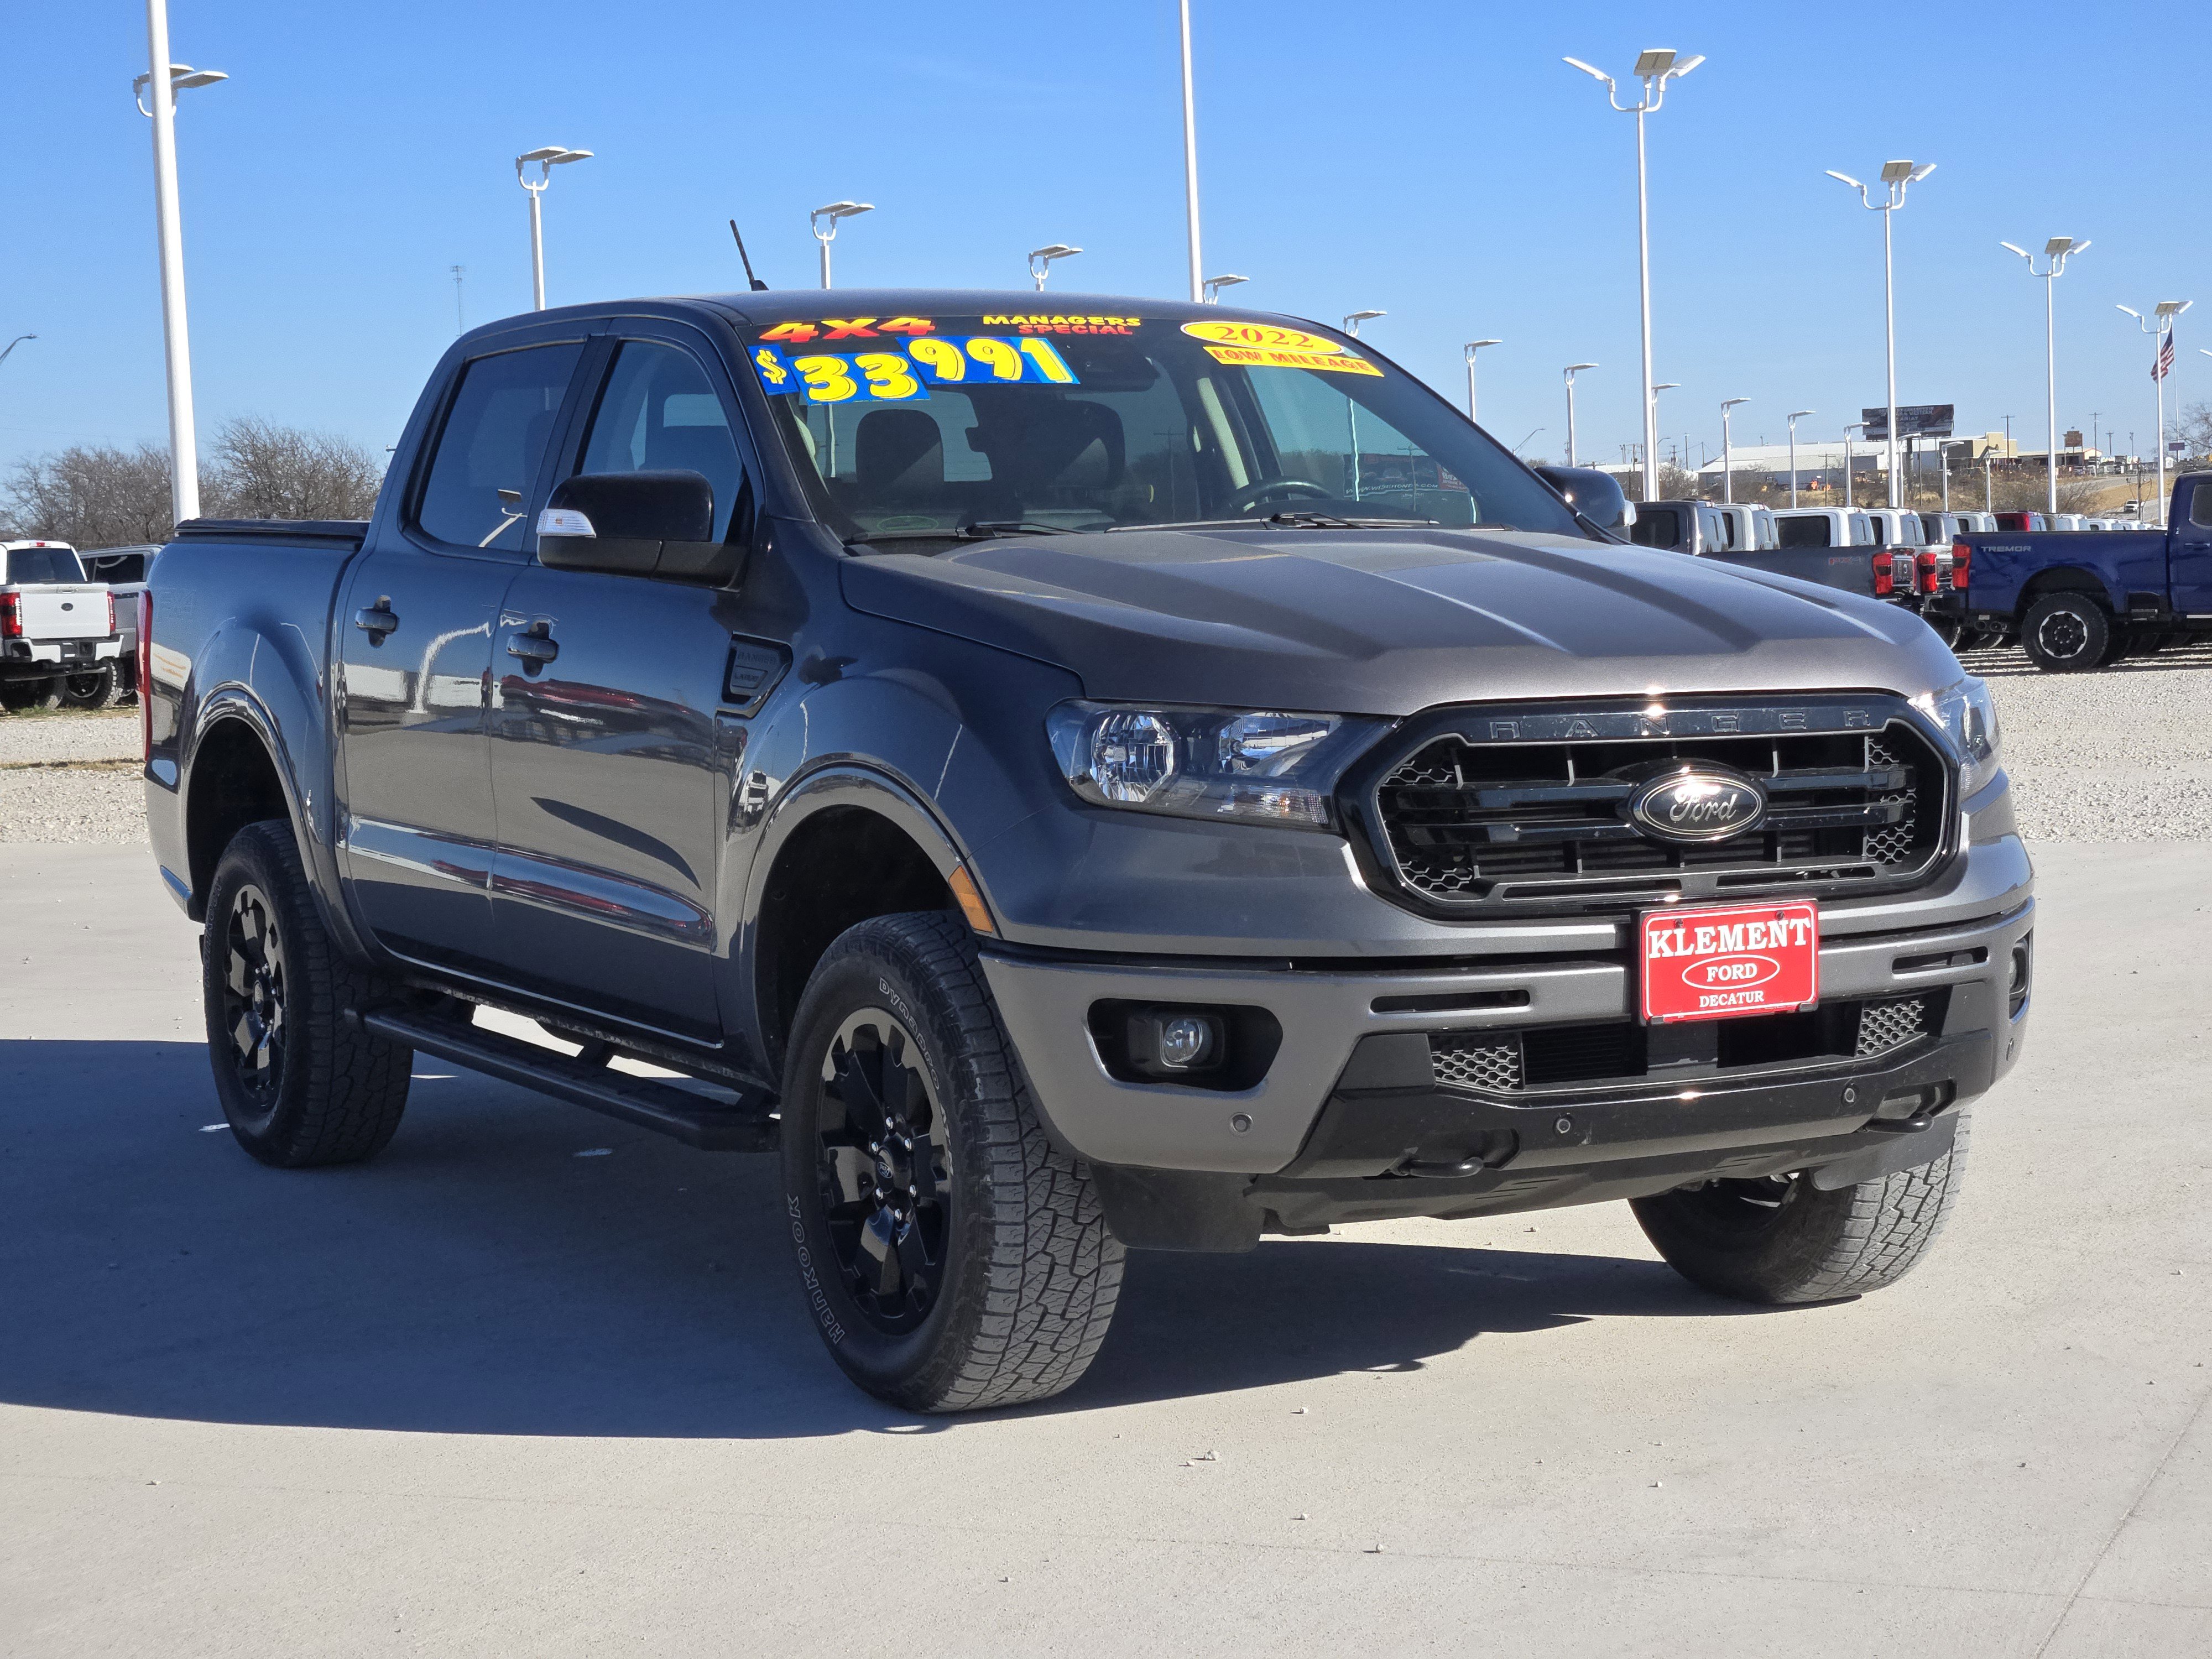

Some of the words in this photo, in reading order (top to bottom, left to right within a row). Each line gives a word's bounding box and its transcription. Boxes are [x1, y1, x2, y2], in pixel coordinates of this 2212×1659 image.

[983, 316, 1141, 326] MANAGERS
[1018, 325, 1133, 335] SPECIAL
[1214, 326, 1314, 348] 2022
[1211, 349, 1263, 362] LOW
[1271, 352, 1373, 372] MILEAGE
[1490, 709, 1870, 739] RANGER
[1670, 783, 1738, 823] Ford
[1648, 917, 1811, 958] KLEMENT
[1706, 963, 1758, 982] FORD
[1699, 990, 1765, 1008] DECATUR
